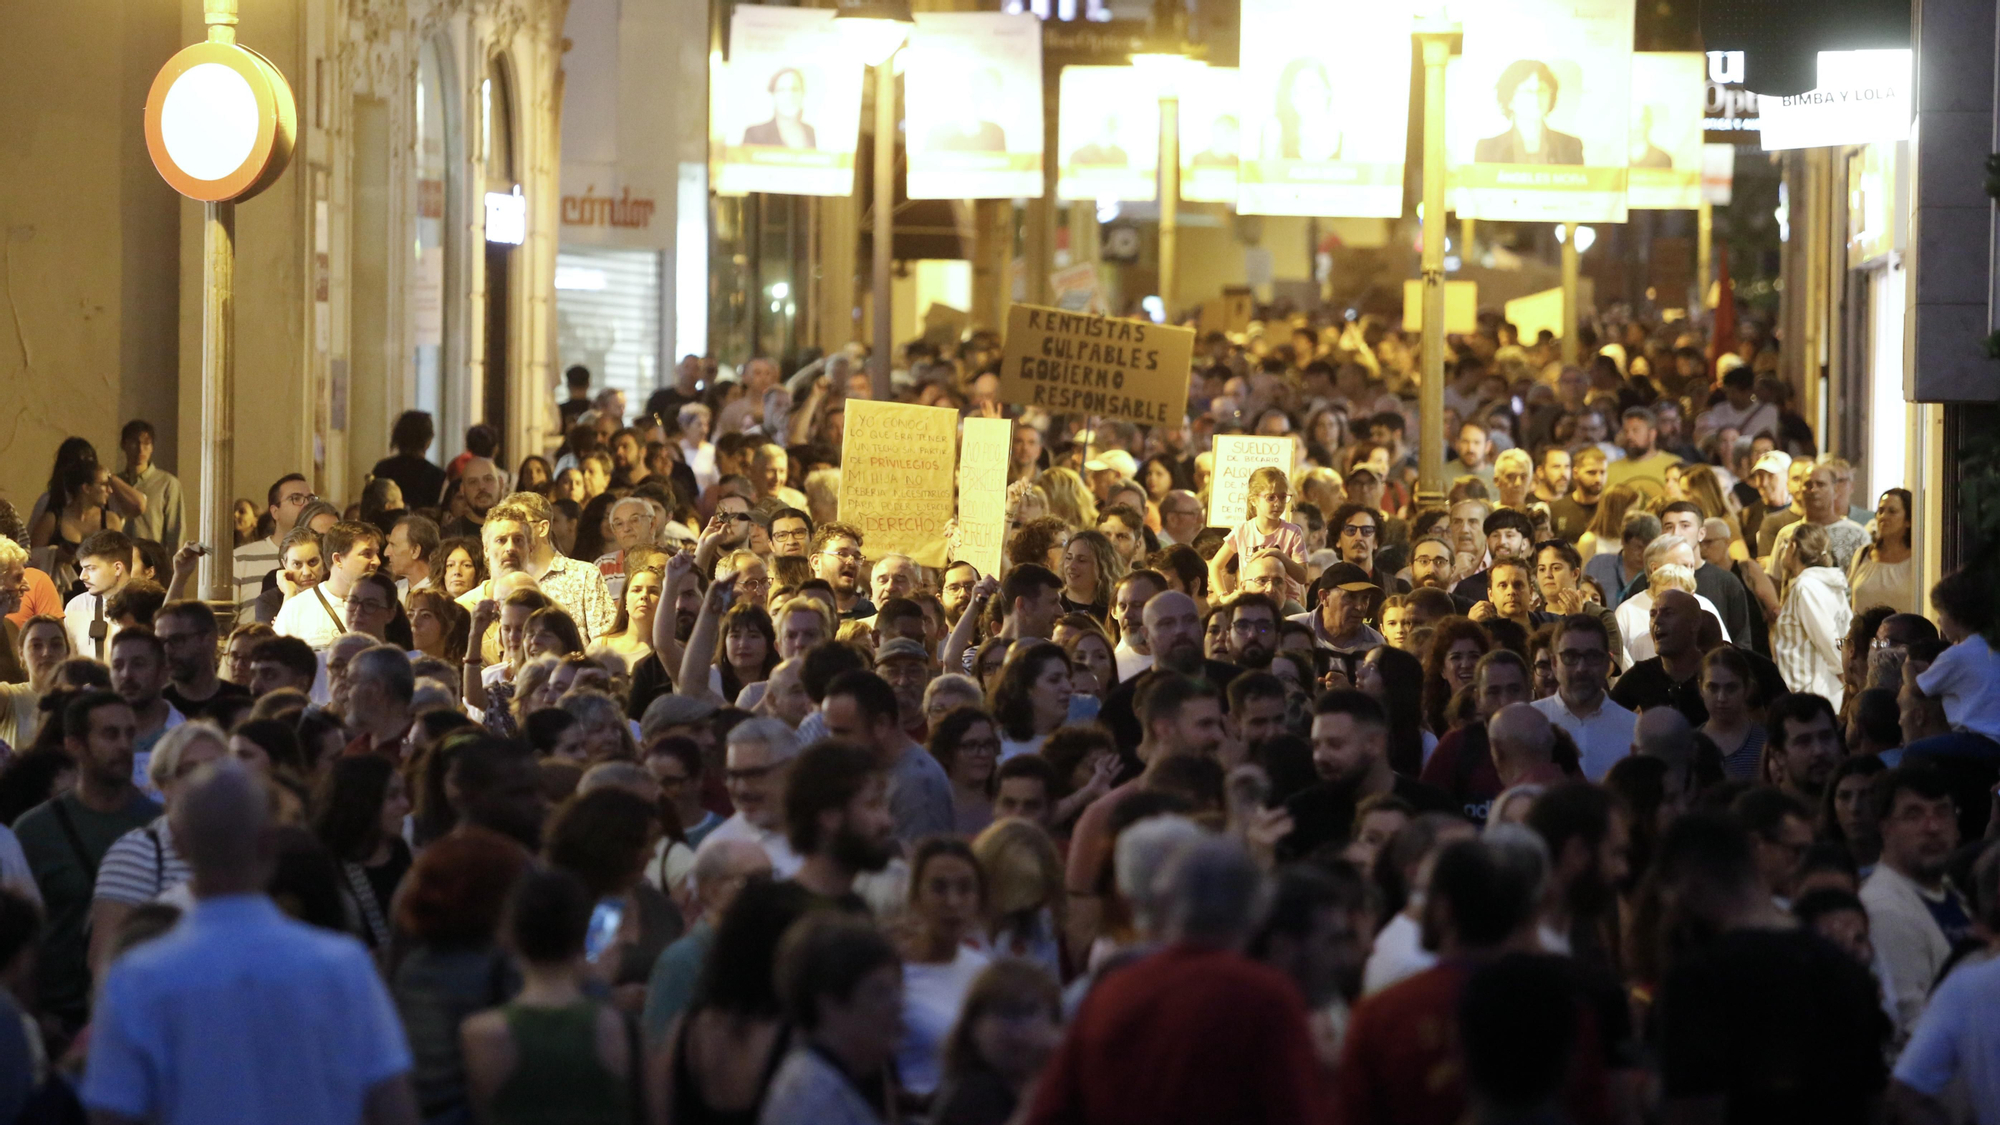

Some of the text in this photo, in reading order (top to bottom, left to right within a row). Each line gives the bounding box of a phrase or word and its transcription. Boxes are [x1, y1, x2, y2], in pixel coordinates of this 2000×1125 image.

[1782, 87, 1896, 107] BIMBA Y LOLA
[561, 184, 656, 228] cóndor
[1027, 309, 1147, 342] RENTISTAS
[1042, 336, 1159, 371] CULPABLES
[1020, 356, 1125, 390] GOBIERNO
[1034, 384, 1168, 422] RESPONSABLE
[858, 414, 929, 431] YO CONOCÍ
[850, 428, 948, 443] LO QUE ERA TENER
[854, 442, 947, 456] UN TECHO SIN PARTIR
[1231, 441, 1281, 456] SUELDO
[850, 456, 863, 465] DE
[848, 469, 923, 485] MI HIJA NO
[1224, 481, 1237, 489] DE
[893, 488, 951, 498] NECESITARLOS
[1228, 491, 1247, 504] CA
[847, 498, 950, 512] PARA PODER EJERCER
[1221, 505, 1232, 513] DE
[866, 517, 935, 533] DERECHO
[1463, 800, 1491, 819] ad
